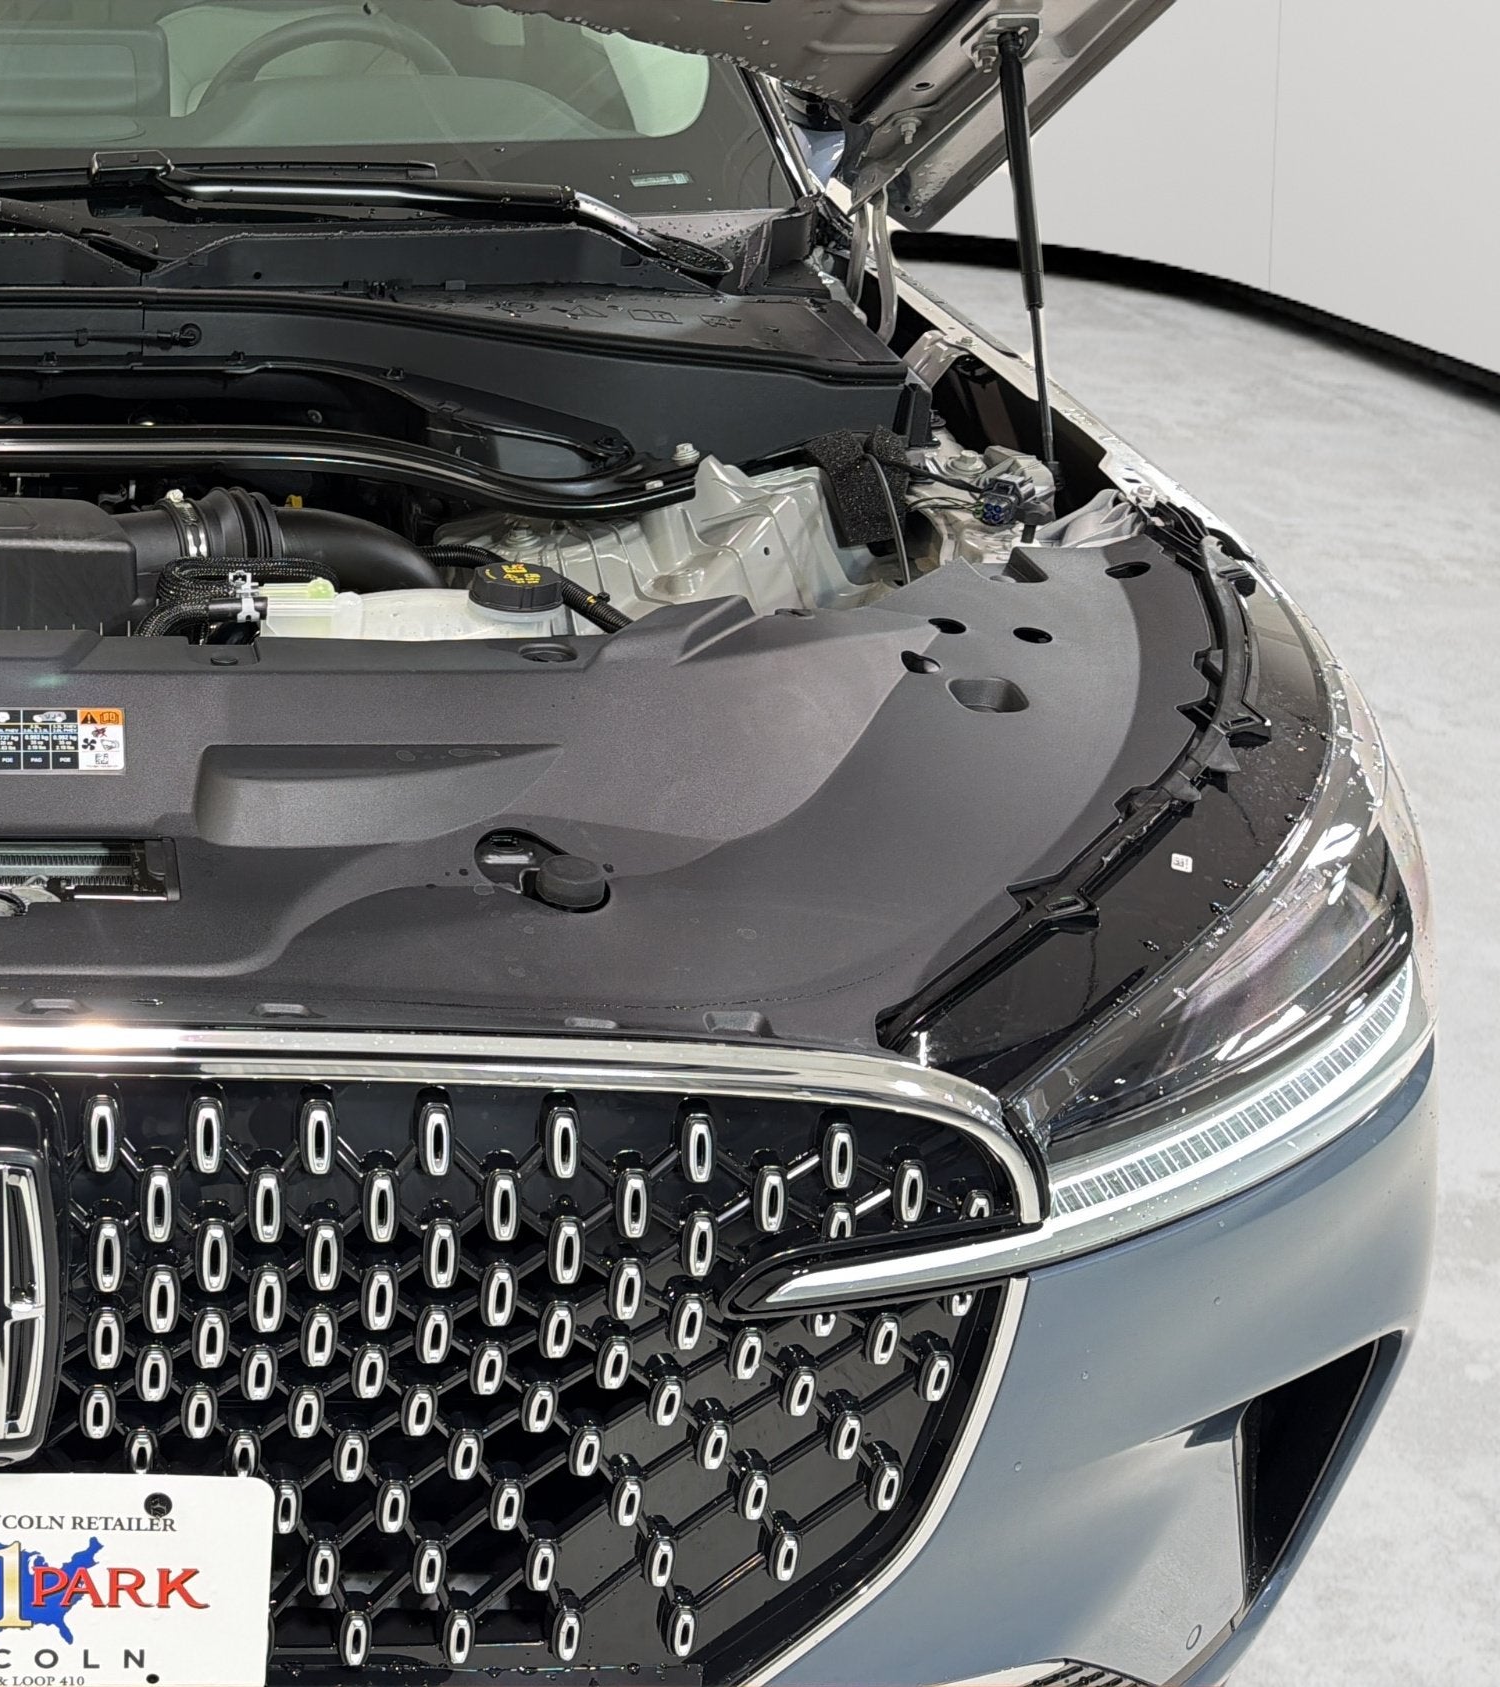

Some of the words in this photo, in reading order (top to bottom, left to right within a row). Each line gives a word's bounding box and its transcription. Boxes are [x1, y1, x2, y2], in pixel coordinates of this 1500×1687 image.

[71, 1516, 177, 1532] RETAILER
[31, 1566, 210, 1609] PARK
[12, 1676, 56, 1686] LOOP
[59, 1676, 85, 1686] 410
